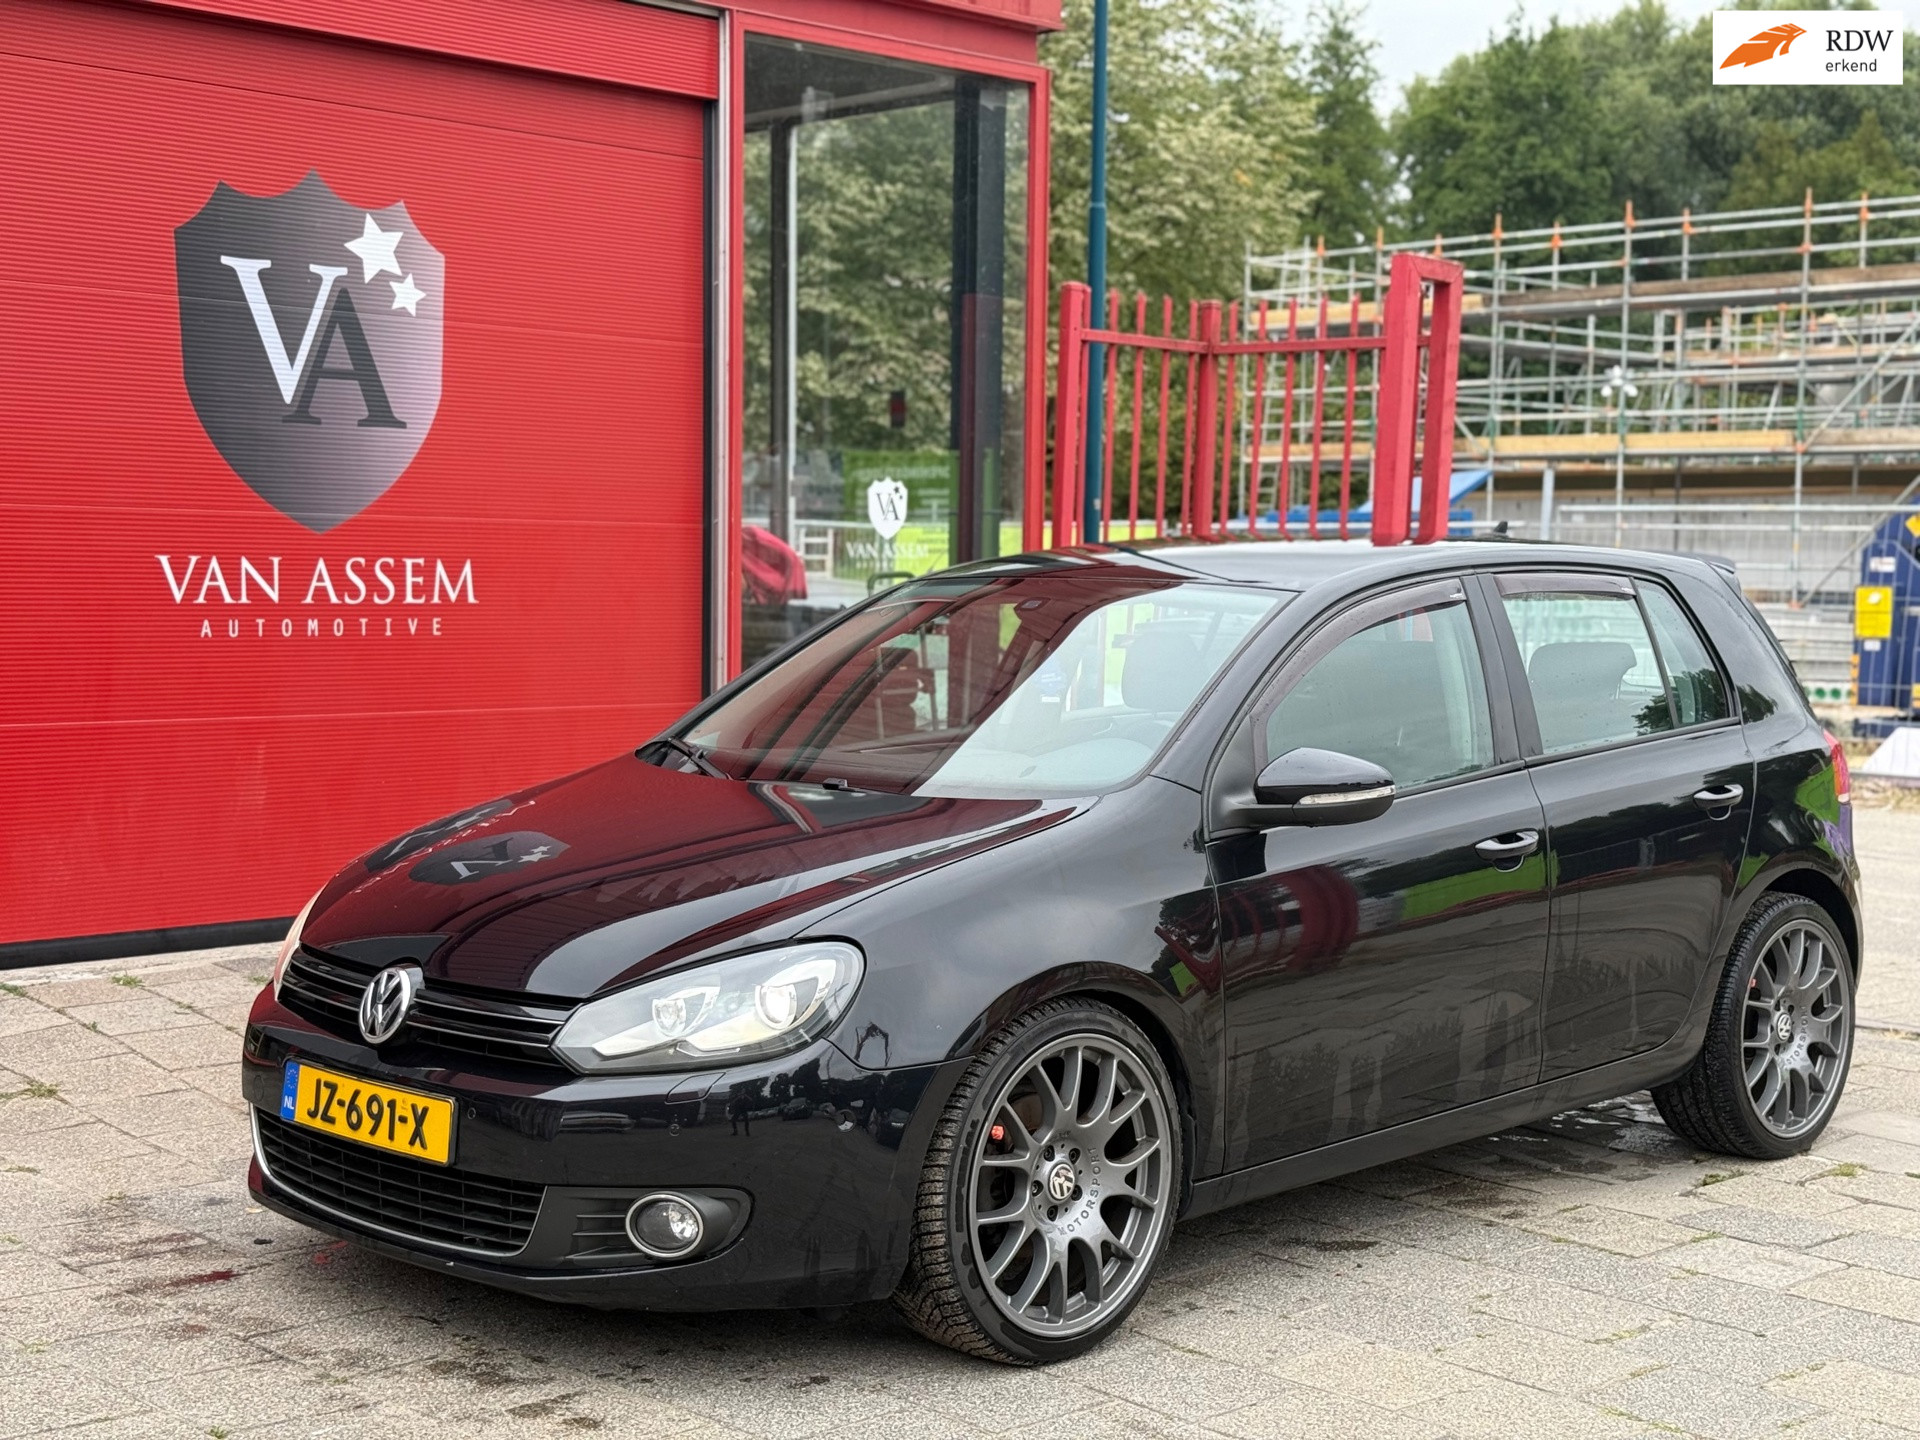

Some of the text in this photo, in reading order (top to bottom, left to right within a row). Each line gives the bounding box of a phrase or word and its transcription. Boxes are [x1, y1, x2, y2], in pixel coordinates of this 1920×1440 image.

[846, 541, 879, 558] VAN
[155, 555, 479, 604] VAN ASSEM
[200, 618, 443, 638] AUTOMOTIVE
[284, 1096, 295, 1110] NL
[307, 1078, 429, 1150] JZ-691-X
[1057, 1147, 1101, 1235] MOTORSPORT
